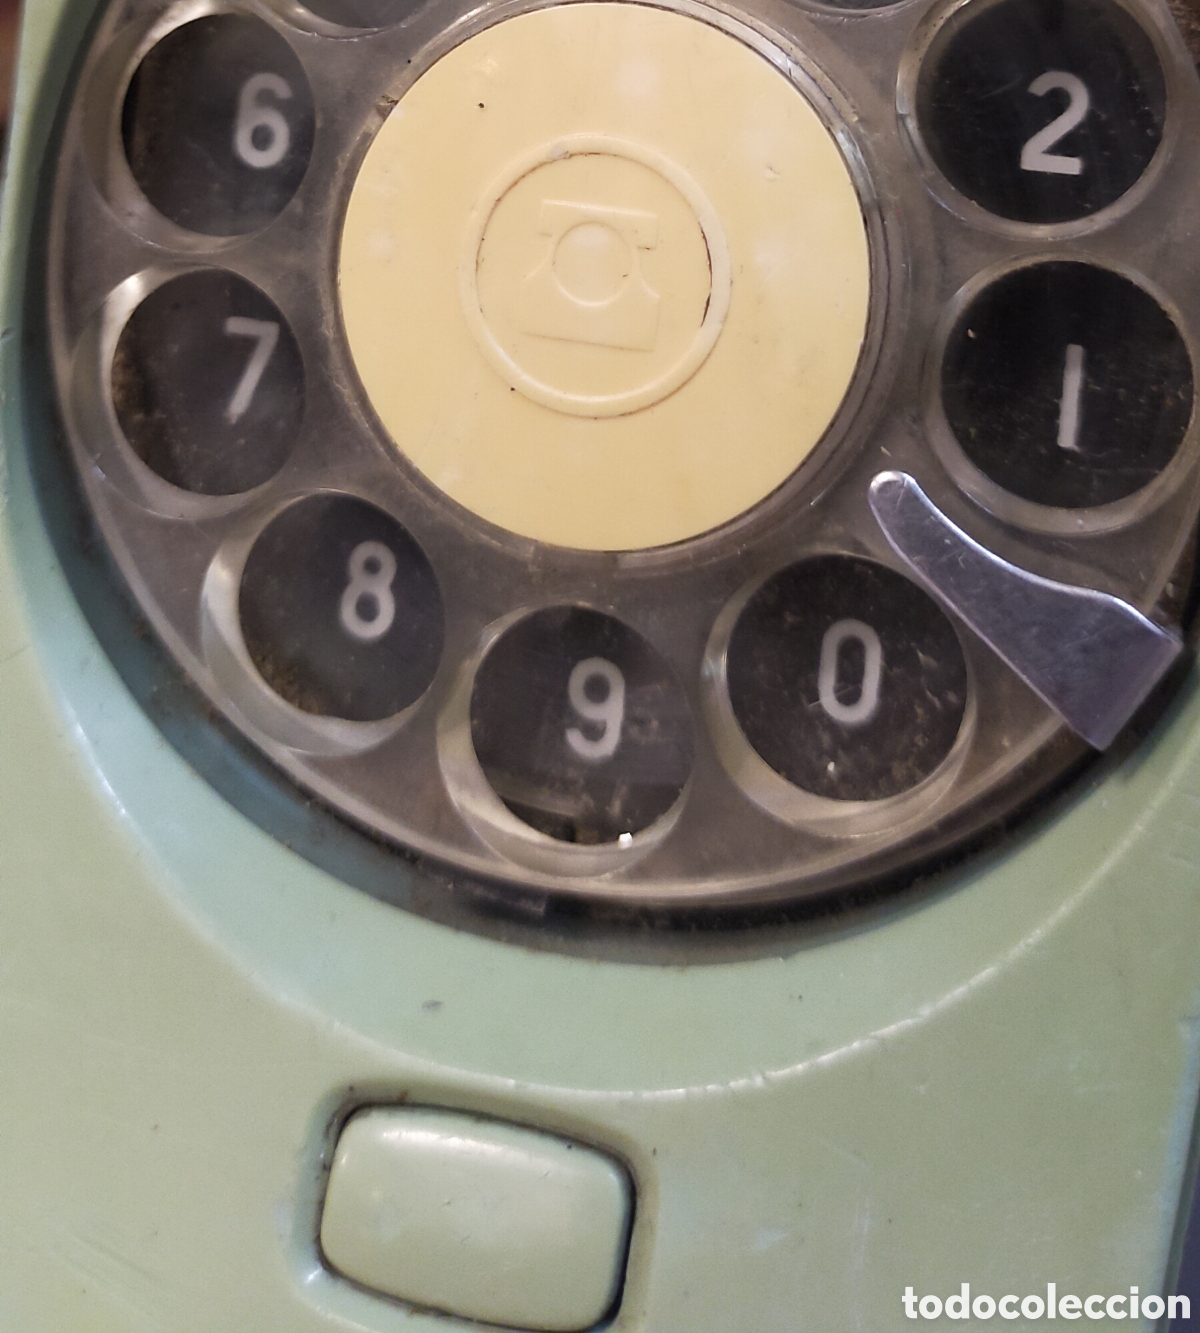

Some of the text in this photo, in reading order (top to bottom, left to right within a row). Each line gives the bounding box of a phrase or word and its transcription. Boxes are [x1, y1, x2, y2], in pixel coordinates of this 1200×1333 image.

[232, 71, 293, 169] 6
[1019, 69, 1090, 176] 2
[222, 316, 281, 426] 7
[1056, 341, 1085, 452] 1
[338, 540, 397, 642] 8
[565, 657, 626, 761] 9
[817, 618, 882, 724] 0
